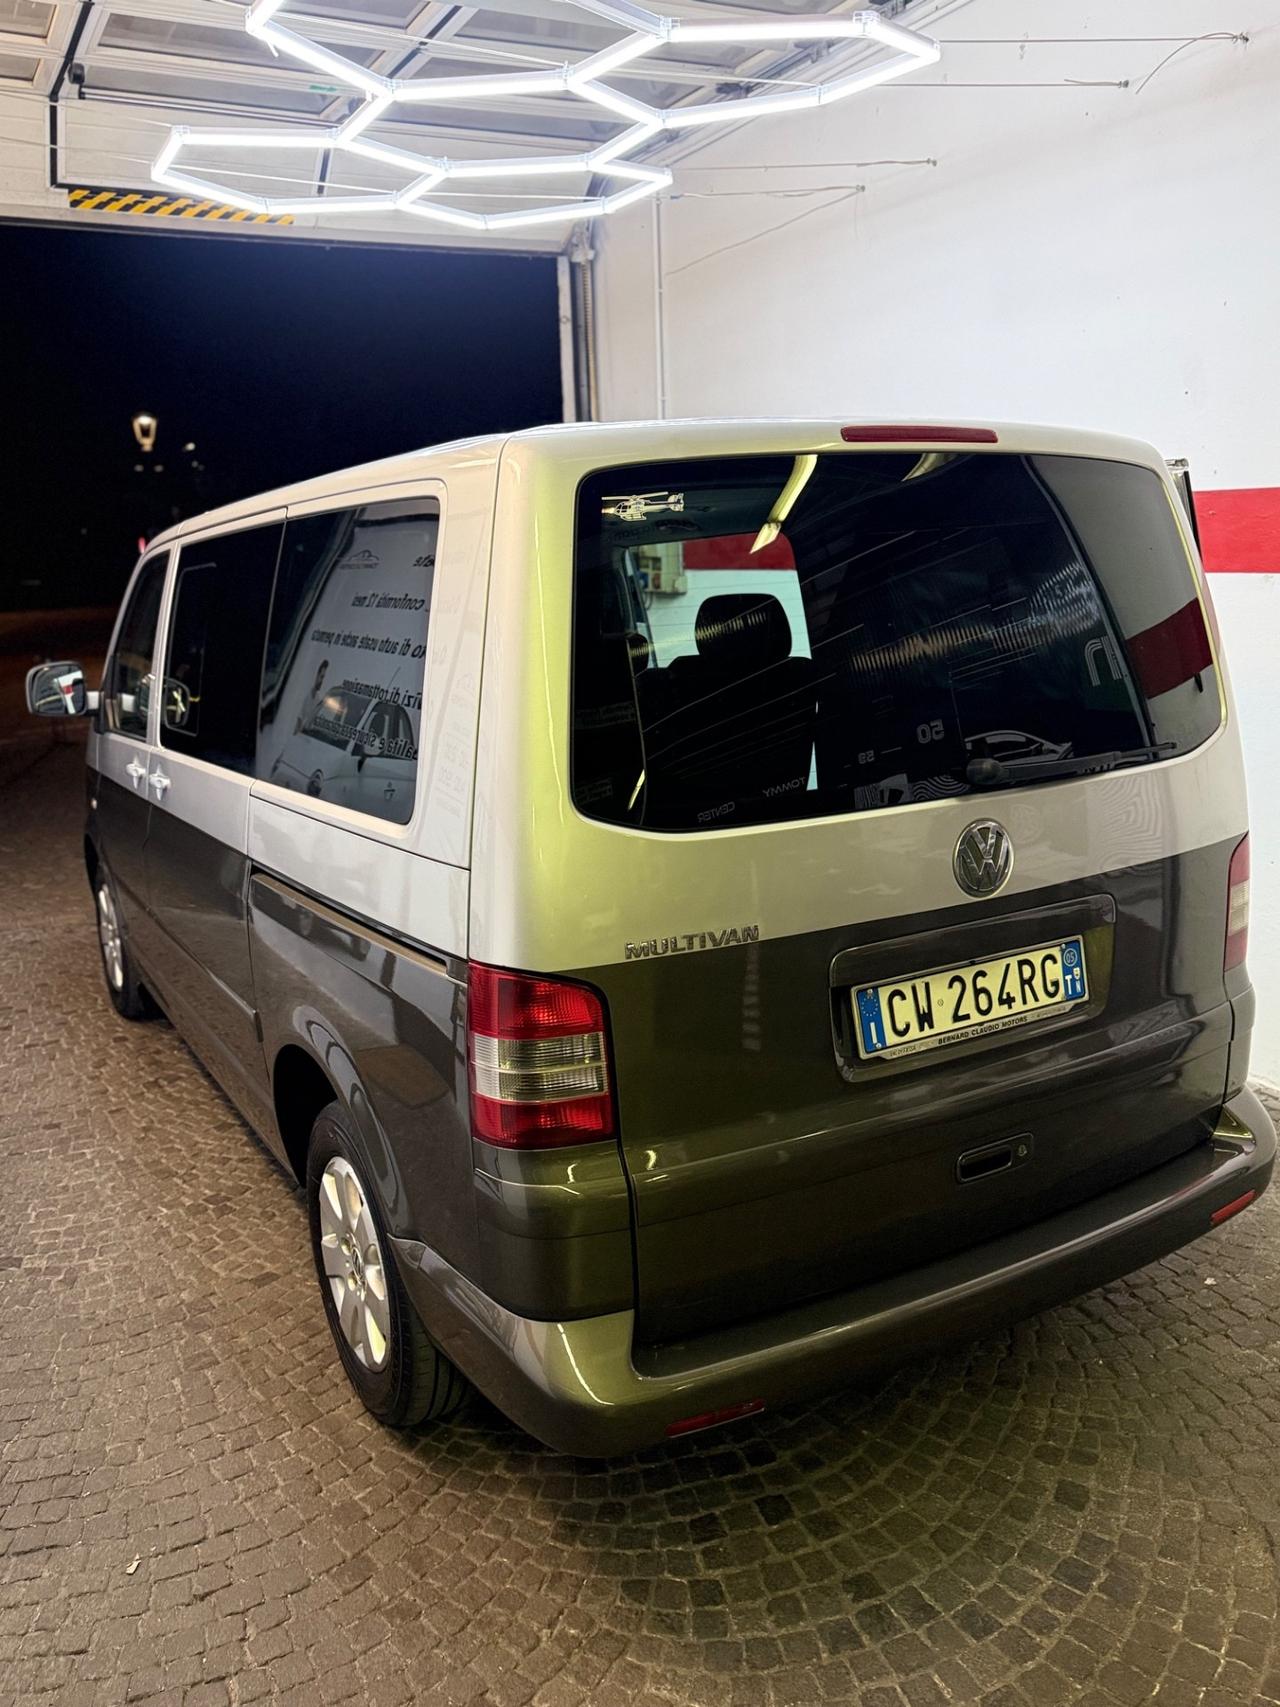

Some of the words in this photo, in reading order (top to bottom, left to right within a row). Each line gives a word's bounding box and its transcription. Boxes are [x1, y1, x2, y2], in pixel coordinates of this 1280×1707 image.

[625, 924, 760, 960] MULTIVAN
[887, 981, 935, 1038] CW
[947, 953, 1061, 1024] 264RG
[938, 1030, 969, 1046] BERNARD
[971, 1023, 1000, 1037] CLAUDIO
[1001, 1016, 1028, 1029] MOTORS
